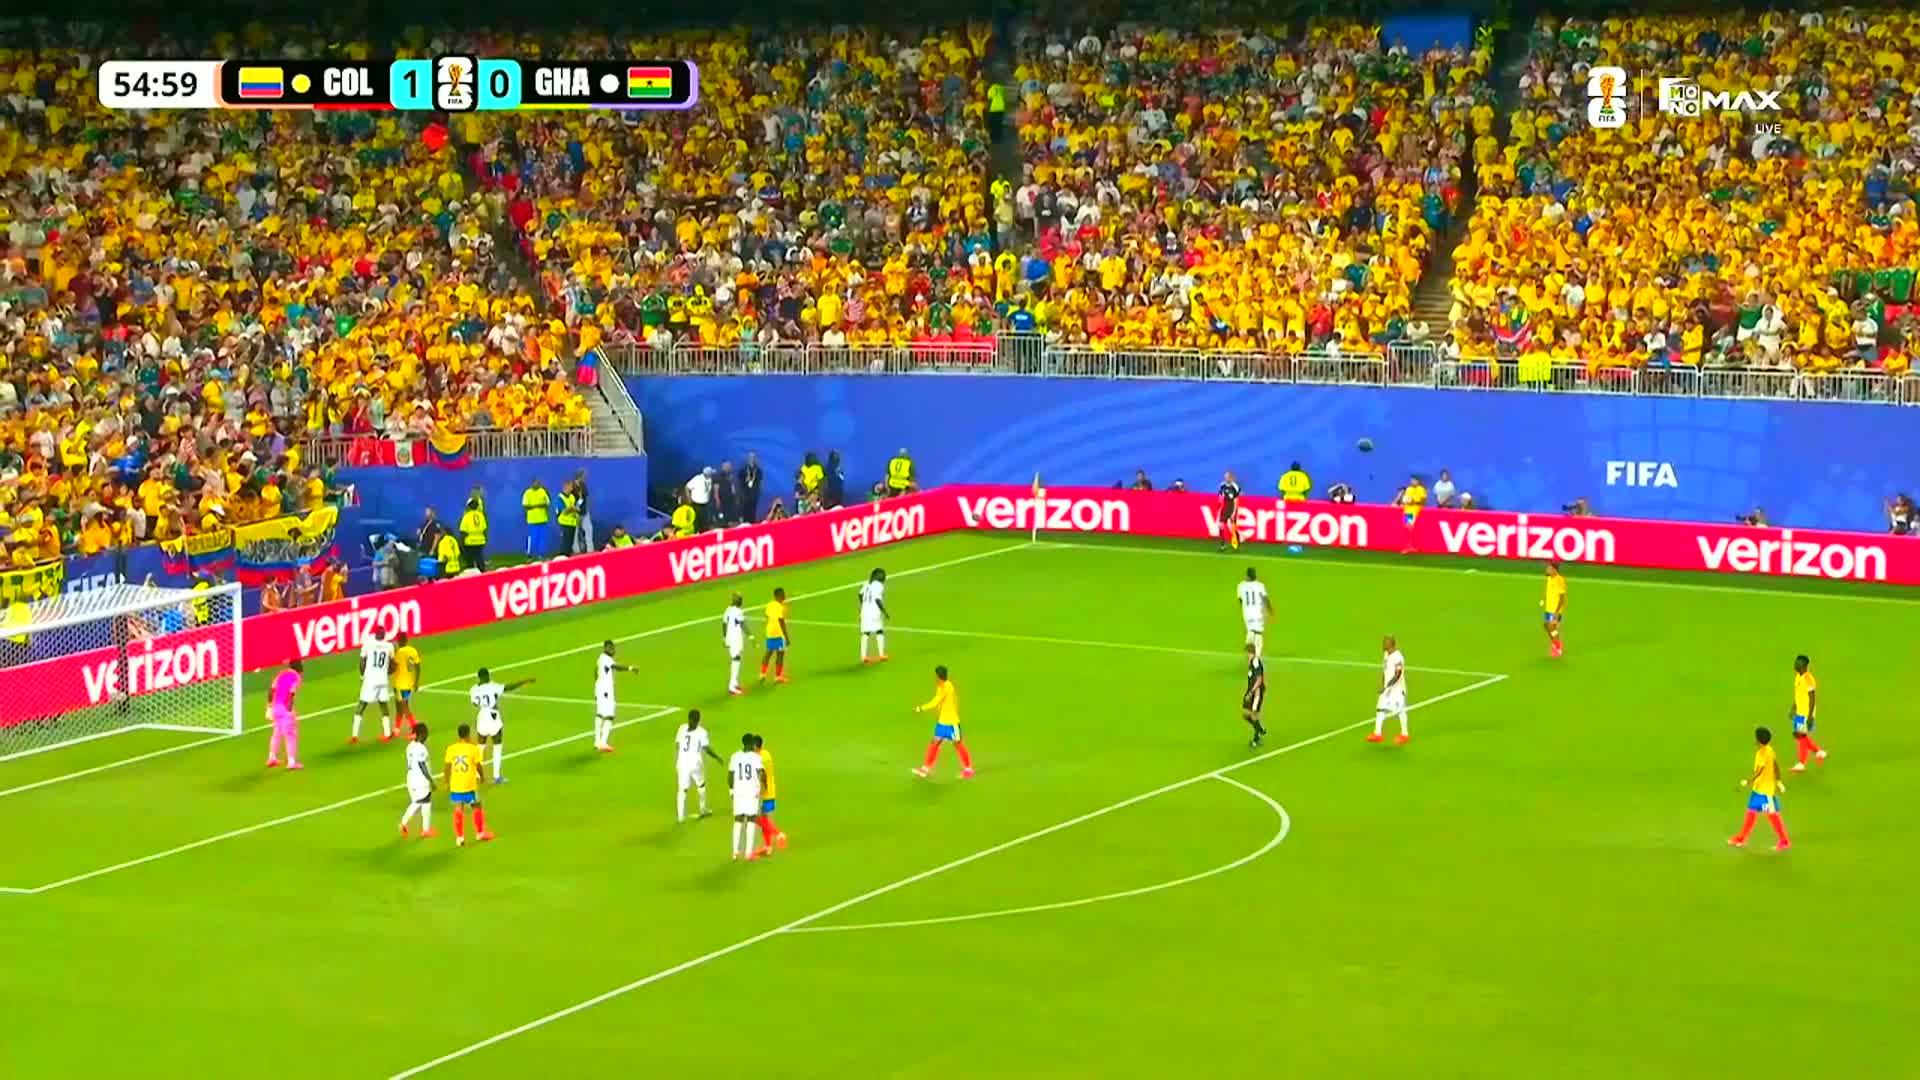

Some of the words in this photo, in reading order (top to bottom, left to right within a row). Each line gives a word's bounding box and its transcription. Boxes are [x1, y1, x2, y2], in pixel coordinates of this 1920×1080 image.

[1606, 460, 1679, 488] FIFA
[830, 502, 925, 552] verizon
[956, 487, 1130, 532] verizon
[1200, 499, 1368, 547] verizon
[668, 533, 774, 584] verizon
[1439, 513, 1615, 563] verizon
[1697, 529, 1887, 580] verizon
[489, 561, 606, 618] verizon
[1245, 591, 1256, 606] 11
[291, 597, 421, 657] verizon
[372, 650, 387, 669] 18
[738, 762, 753, 781] 19
